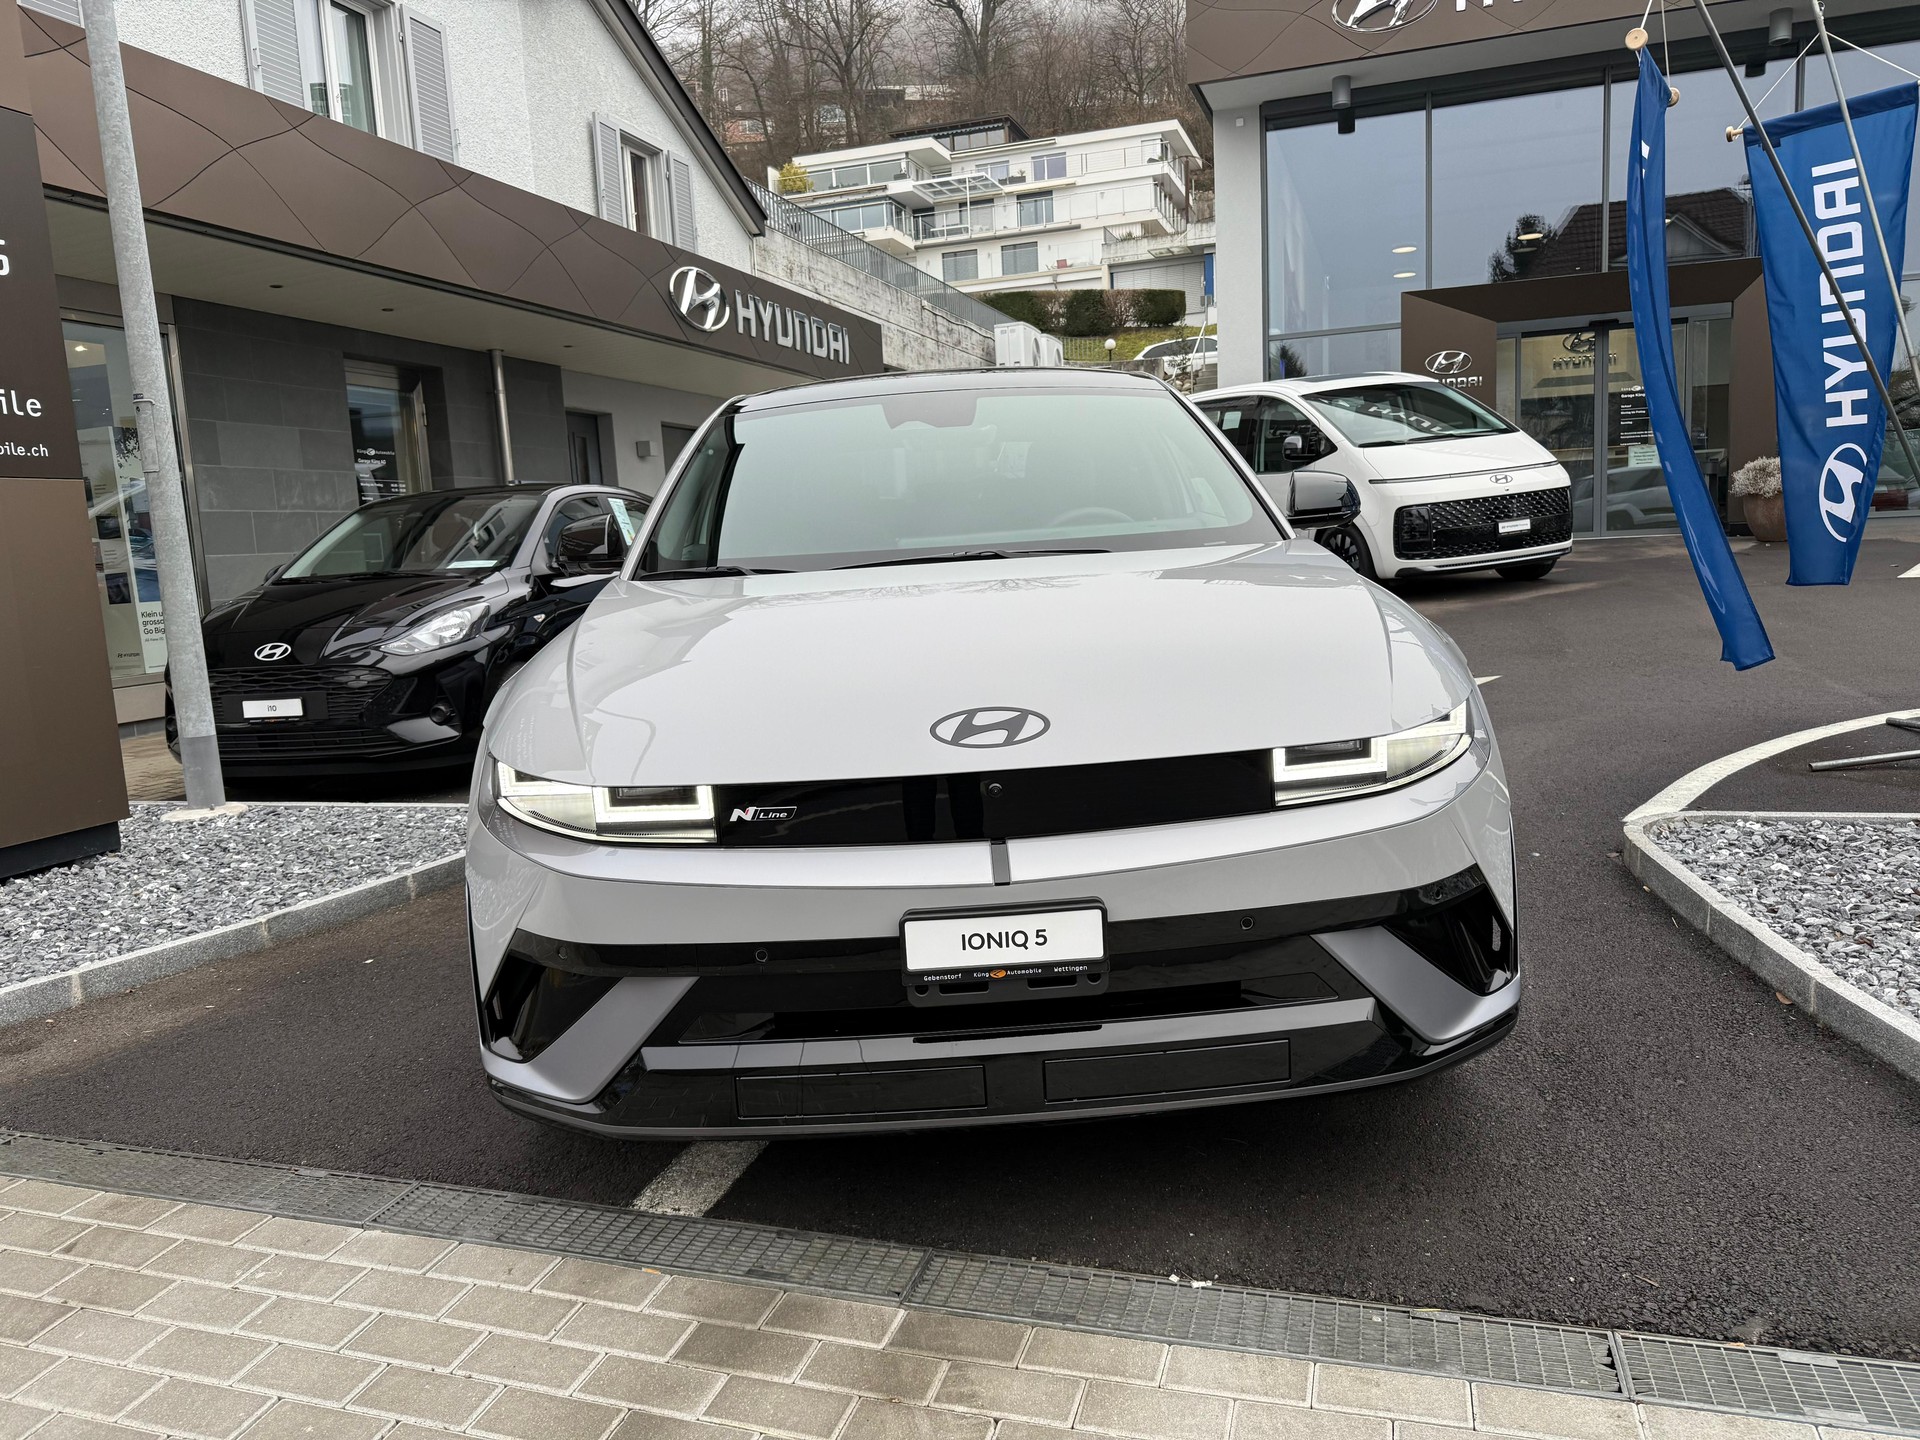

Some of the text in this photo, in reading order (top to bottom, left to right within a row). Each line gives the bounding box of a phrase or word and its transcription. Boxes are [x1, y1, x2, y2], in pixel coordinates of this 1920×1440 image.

[1811, 158, 1868, 428] HYUNDAI
[734, 289, 850, 365] HYUNDAI
[1553, 353, 1616, 370] HYUNI
[141, 610, 158, 618] Klein
[143, 626, 166, 635] Go Big
[759, 811, 788, 819] Line
[961, 928, 1048, 951] IONIQ 5
[923, 964, 1088, 982] Gebenstorf Küng Automobile Wettingen
